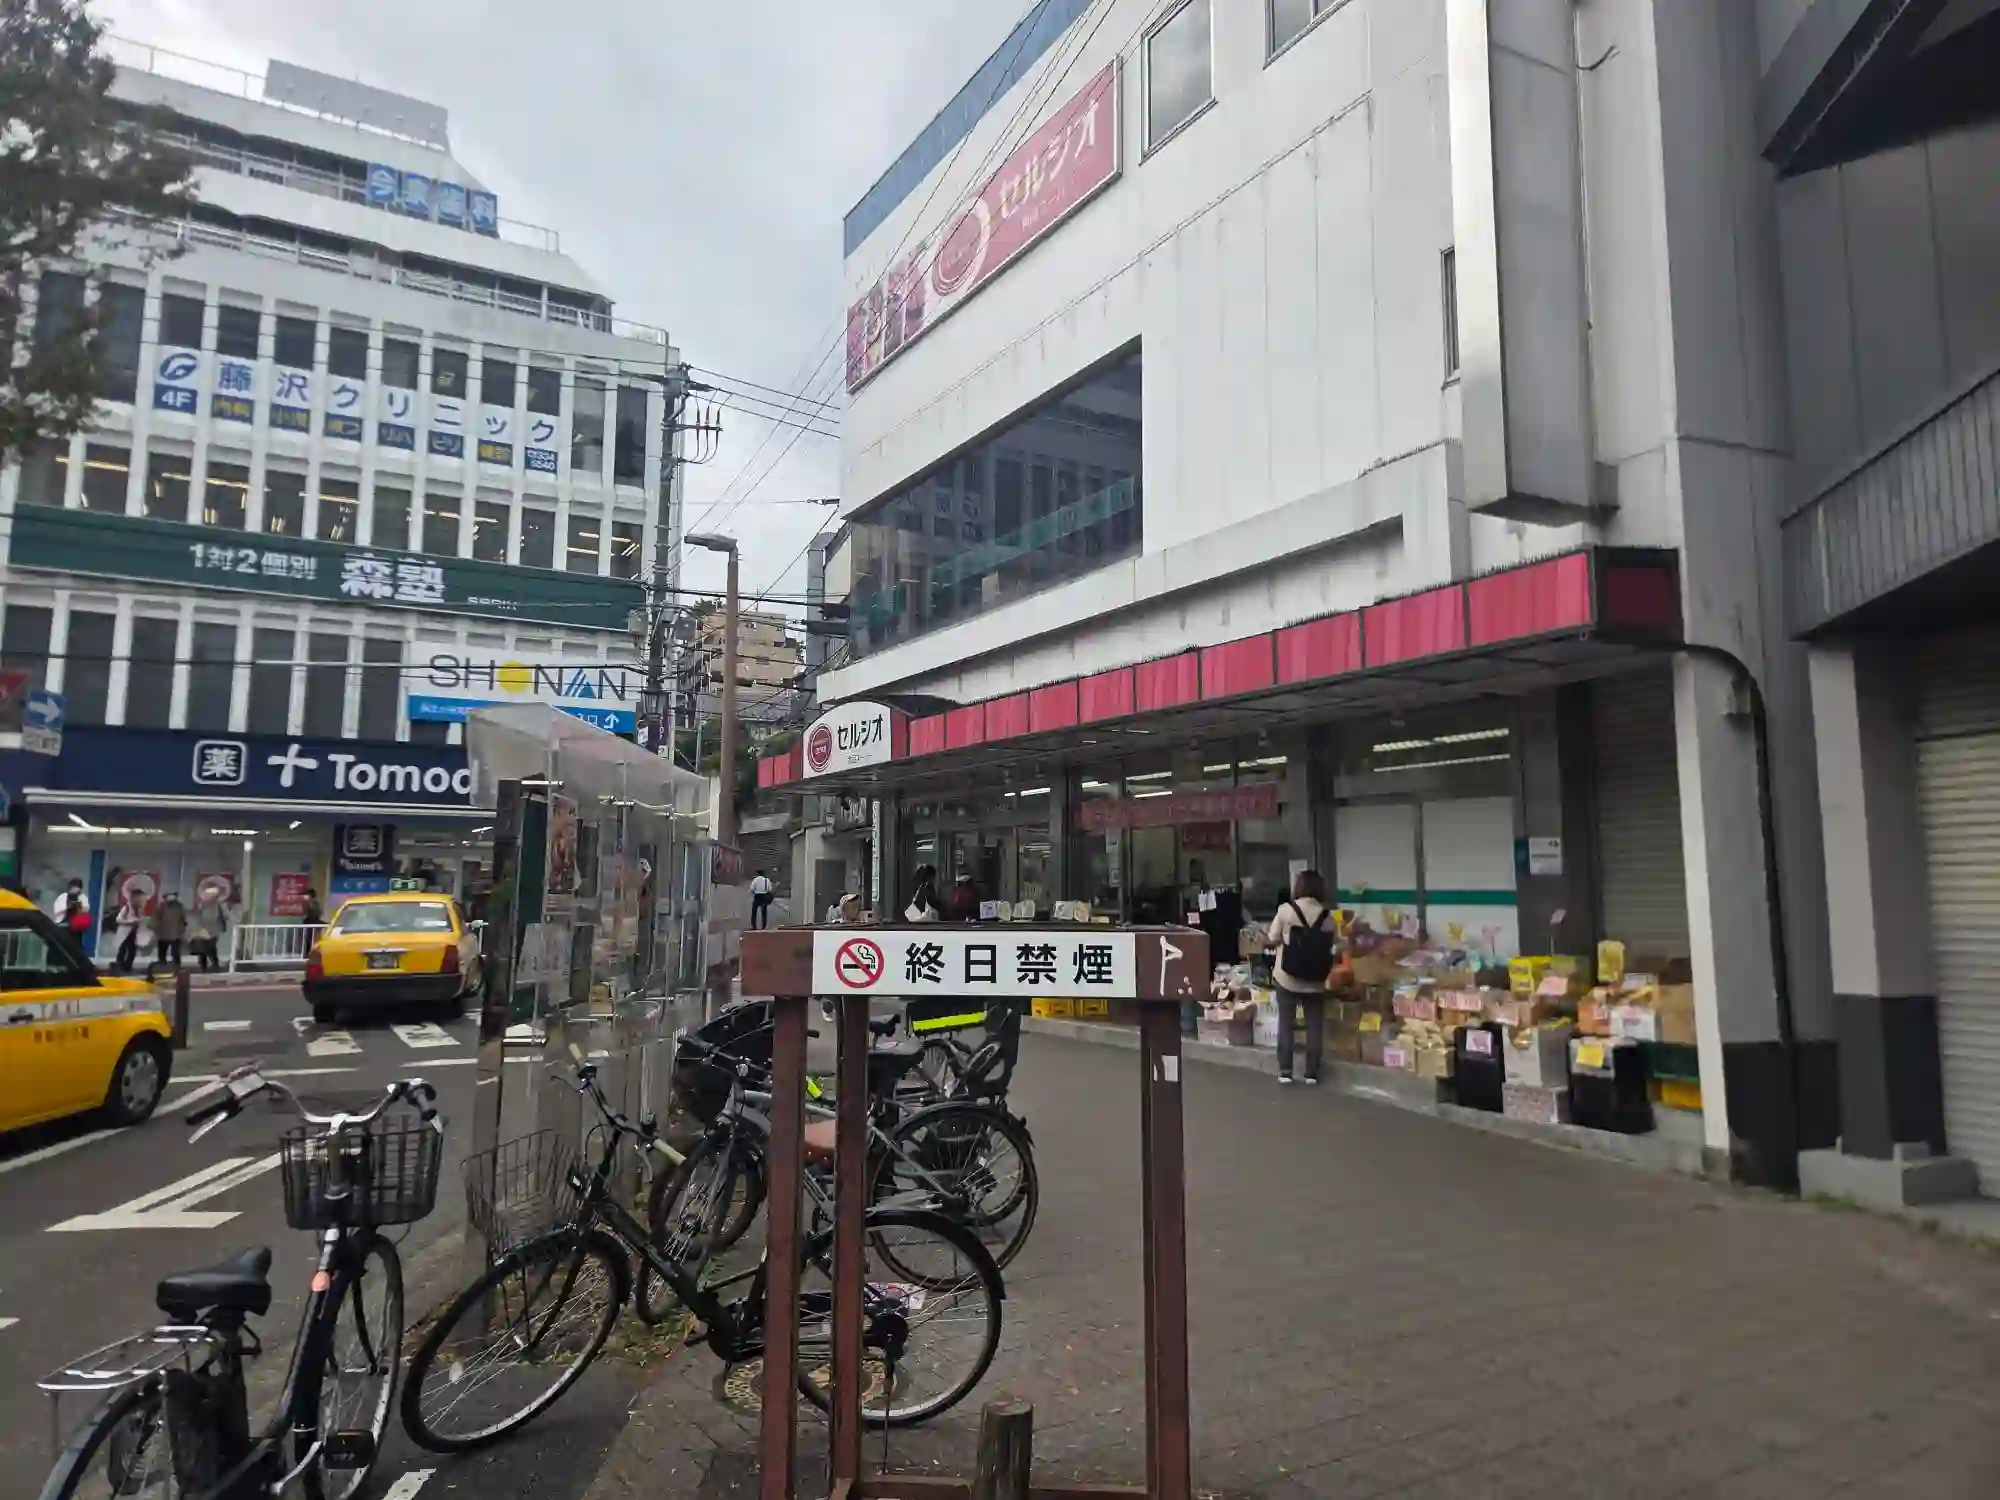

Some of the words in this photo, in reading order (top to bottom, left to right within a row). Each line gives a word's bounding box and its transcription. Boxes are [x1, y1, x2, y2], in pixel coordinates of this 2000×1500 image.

[999, 98, 1100, 219] セルシオ
[161, 390, 192, 408] 4F
[218, 361, 555, 443] 藤沢クリニック
[341, 552, 445, 603] 森塾
[838, 713, 884, 751] セルシオ
[202, 748, 237, 778] 薬
[905, 942, 1113, 984] 終日禁煙
